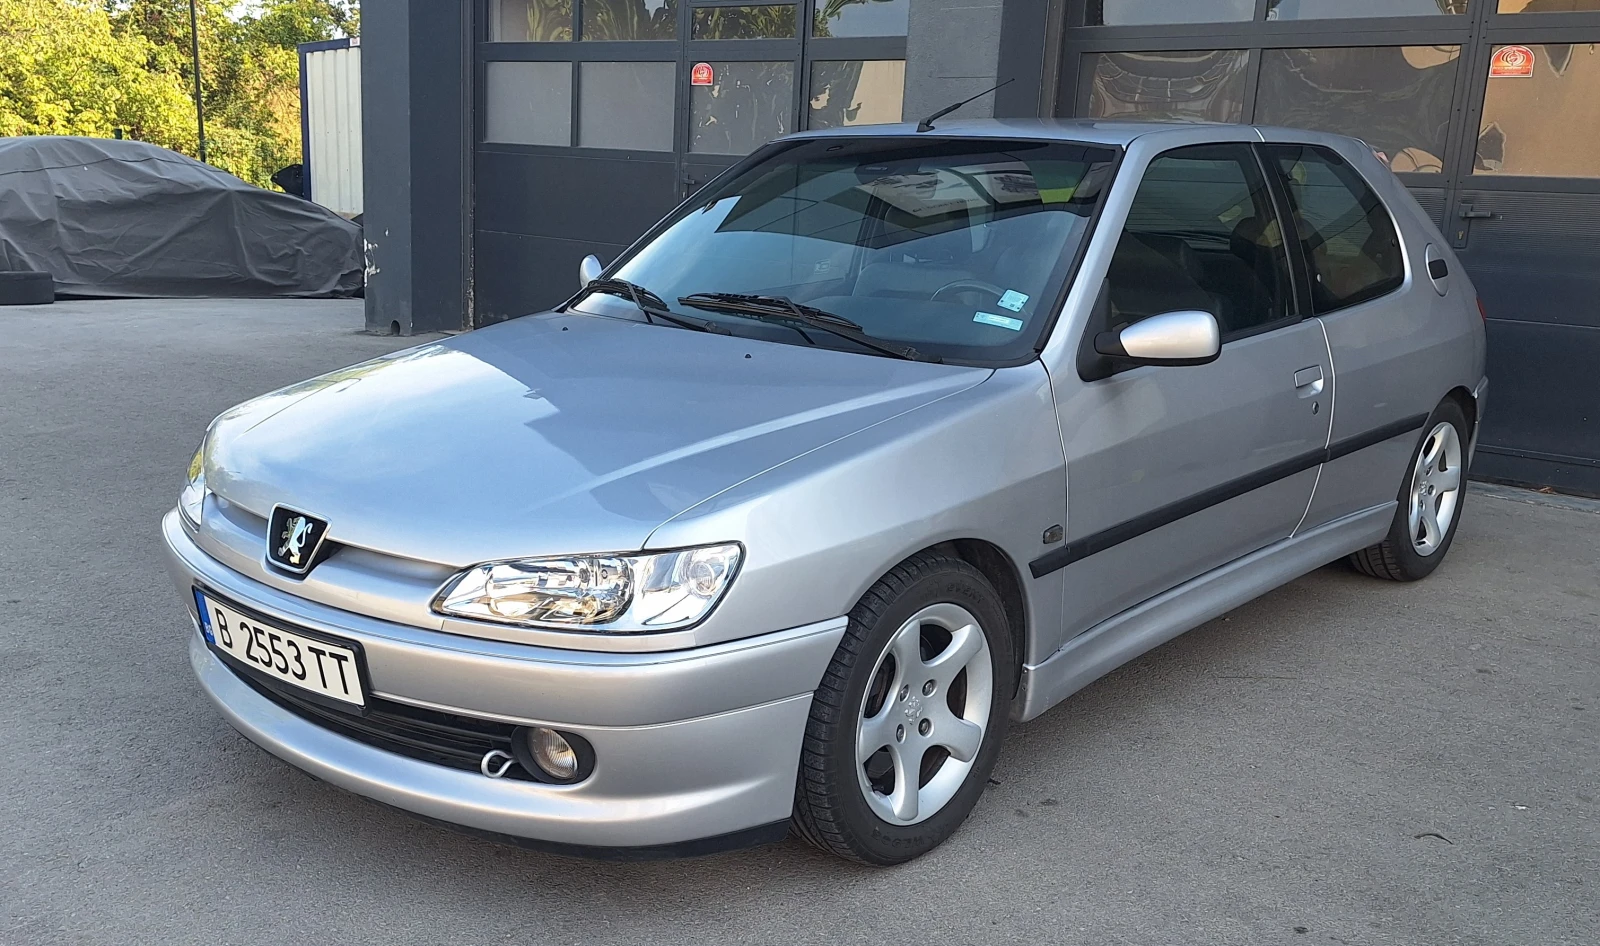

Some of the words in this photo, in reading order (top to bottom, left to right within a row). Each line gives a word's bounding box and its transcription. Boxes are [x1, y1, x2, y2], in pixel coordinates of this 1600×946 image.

[214, 607, 233, 649] B
[239, 621, 307, 681] 2553
[307, 645, 349, 695] TT
